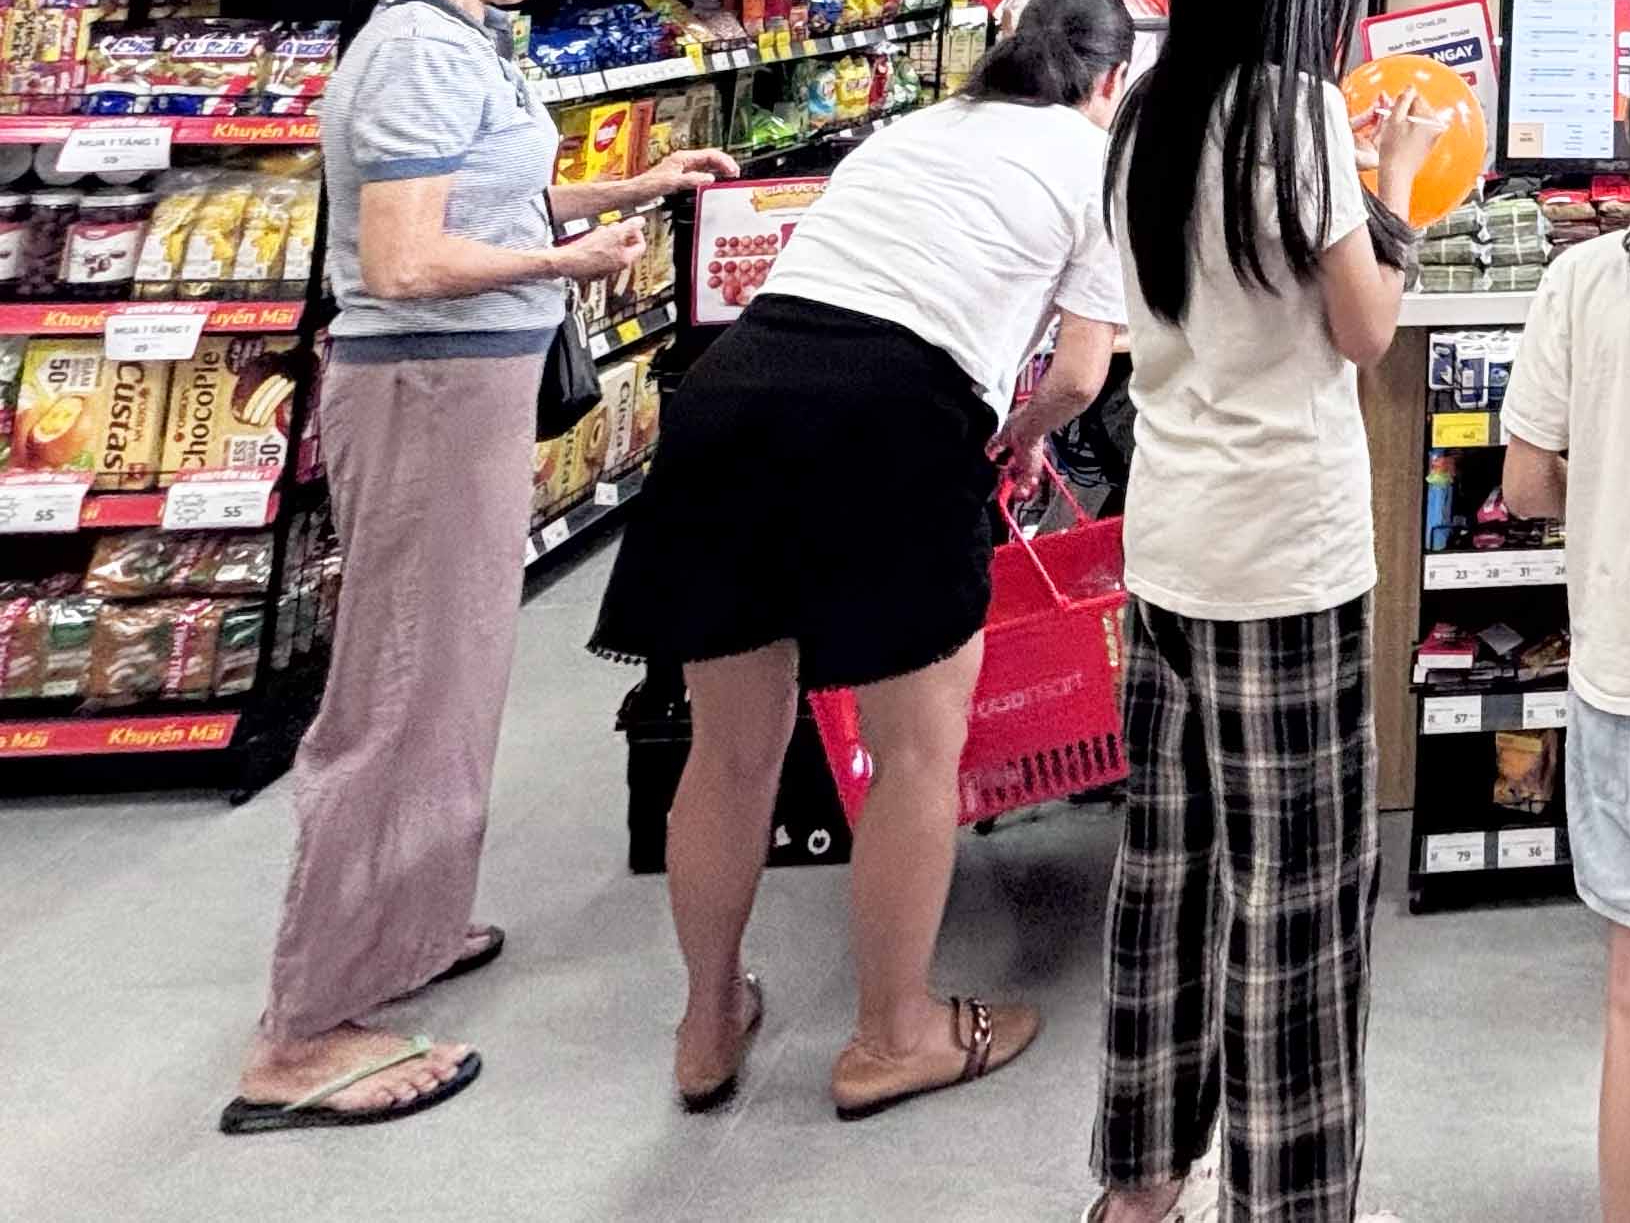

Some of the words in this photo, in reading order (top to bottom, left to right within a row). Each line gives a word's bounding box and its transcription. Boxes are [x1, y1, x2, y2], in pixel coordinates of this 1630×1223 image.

[1433, 44, 1474, 62] NGAY
[213, 122, 284, 140] Khuyến
[223, 506, 243, 519] 55
[108, 726, 184, 745] Khuyến
